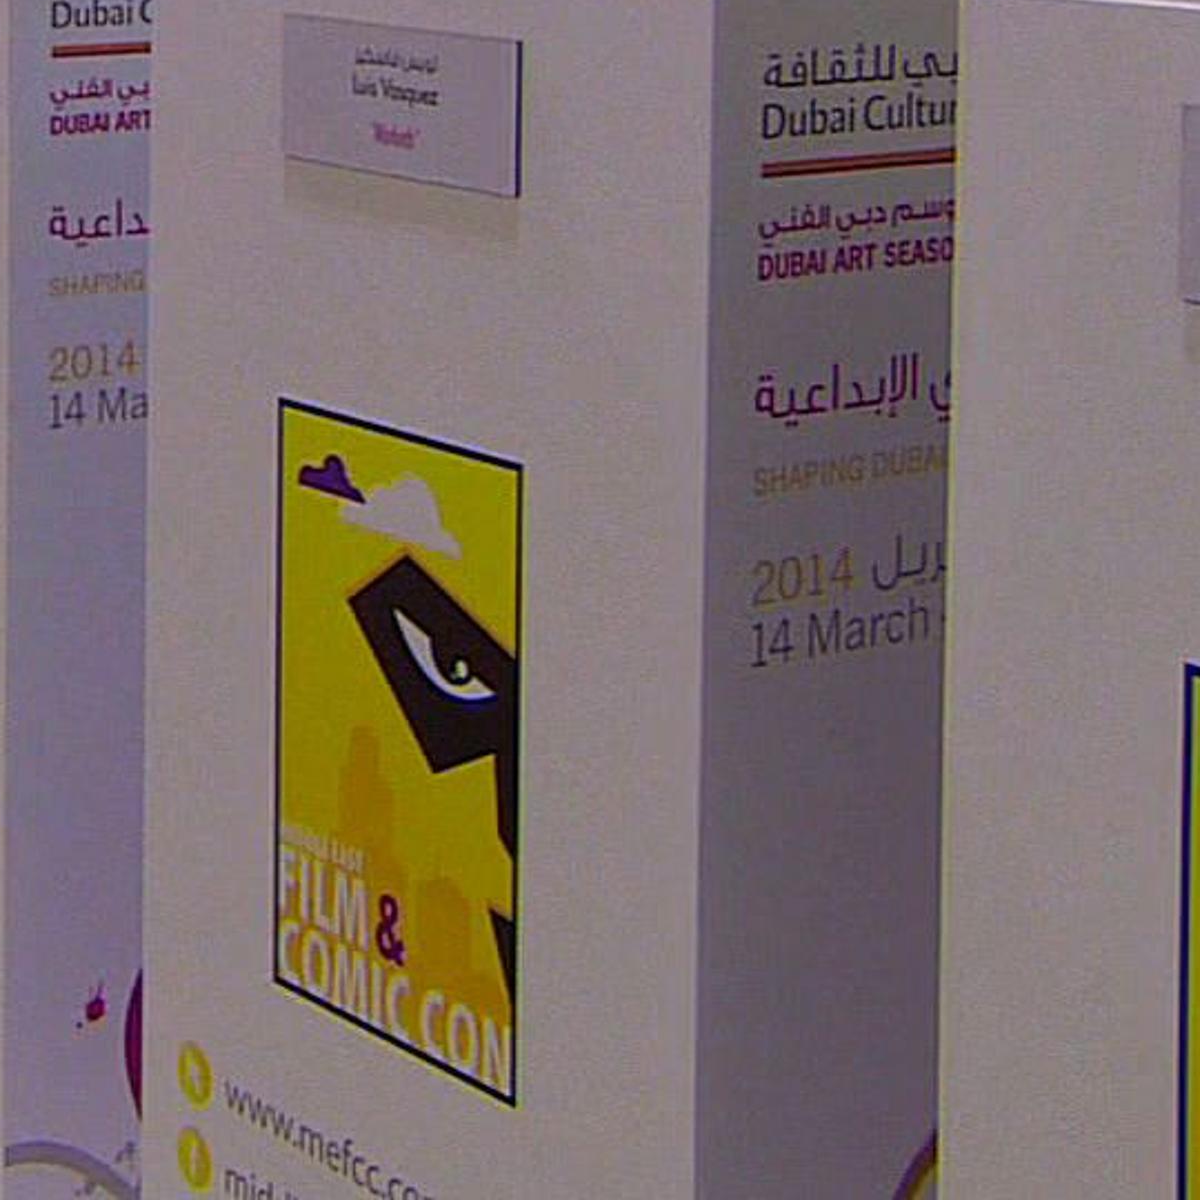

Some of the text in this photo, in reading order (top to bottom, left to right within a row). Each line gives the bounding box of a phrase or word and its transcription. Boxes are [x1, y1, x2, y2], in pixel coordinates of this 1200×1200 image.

[764, 42, 896, 87] للثقافة
[50, 109, 152, 135] DUBAI ART
[761, 98, 855, 140] Dubai
[759, 203, 831, 247] الفني
[835, 205, 887, 239] دبي
[758, 236, 955, 282] DUBAI ART SEASO
[49, 340, 141, 382] 2014
[50, 386, 148, 429] 14 Ma
[755, 352, 919, 427] الإبداعية
[754, 454, 864, 497] SHAPING
[752, 546, 854, 605] 2014
[751, 599, 929, 668] 14 March
[280, 847, 368, 952] FILM
[376, 895, 404, 966] &
[279, 918, 512, 1099] COMIC CON
[224, 1080, 439, 1200] www.mefcc.co
